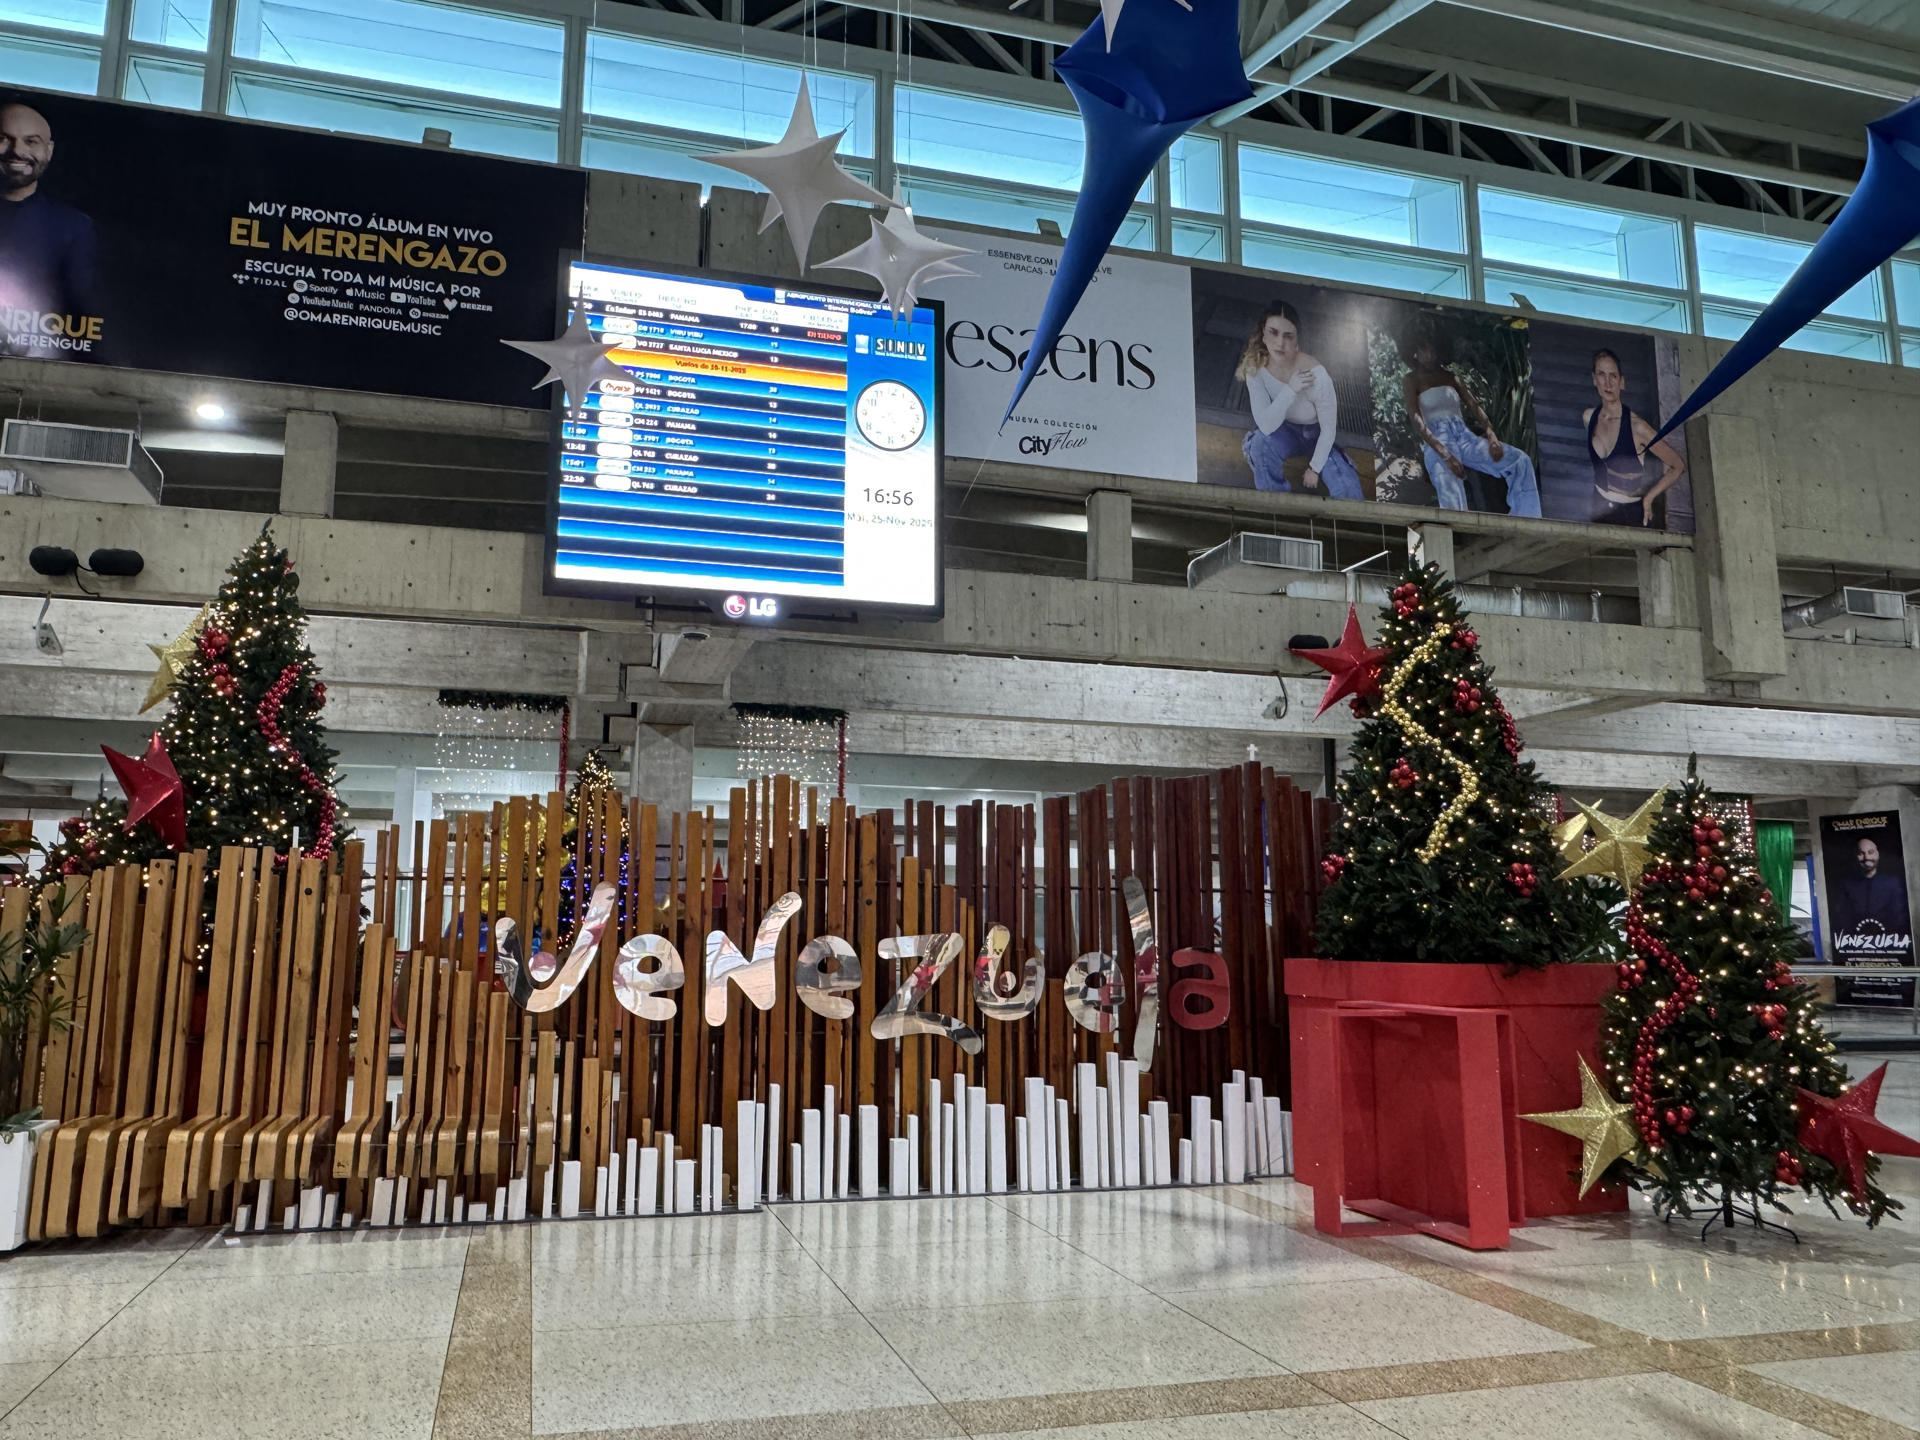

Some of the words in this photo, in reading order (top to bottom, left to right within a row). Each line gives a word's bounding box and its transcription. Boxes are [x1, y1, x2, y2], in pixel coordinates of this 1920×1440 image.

[248, 201, 287, 218] MUY
[291, 204, 362, 227] PRONTO
[366, 212, 423, 236] ÁLBUM
[427, 224, 448, 239] EN
[452, 226, 493, 244] VIVO
[229, 216, 270, 249] EL
[281, 223, 508, 277] MERENGAZO
[988, 249, 1053, 266] ESSENSVE.COM
[1003, 262, 1043, 275] CARACAS
[245, 259, 316, 279] ESCUCHA
[321, 269, 364, 285] TODA
[368, 274, 385, 287] MI
[389, 275, 445, 294] MÚSICA
[451, 284, 481, 299] POR
[253, 277, 288, 288] TIDAL
[309, 283, 338, 295] Spotify
[354, 288, 386, 300] Music
[406, 294, 436, 306] YouTube
[302, 295, 331, 307] YouTube
[331, 298, 354, 310] Music
[359, 304, 402, 316] PANDORA
[284, 307, 442, 336] @OMARENRIQUEMUSIC
[669, 313, 700, 323] PANAMA
[7, 333, 92, 352] MERENGUE
[669, 343, 692, 352] SANTA
[692, 346, 712, 355] LUCIA
[712, 348, 739, 358] MEXICO
[876, 338, 925, 355] SINIV
[675, 361, 698, 369] Vuelos
[668, 375, 696, 384] BOGOTA
[666, 390, 696, 399] BOGOTA
[666, 421, 697, 431] PANAMA
[1008, 415, 1039, 424] NUEVA
[1043, 419, 1098, 431] COLECCIÓN
[1019, 435, 1052, 456] City
[1050, 429, 1087, 451] Flow
[664, 453, 699, 462] CURAZAO
[664, 484, 698, 493] CURAZAO
[863, 487, 914, 506] 16:56
[749, 597, 777, 616] LG
[1834, 928, 1912, 950] VENEZUELA
